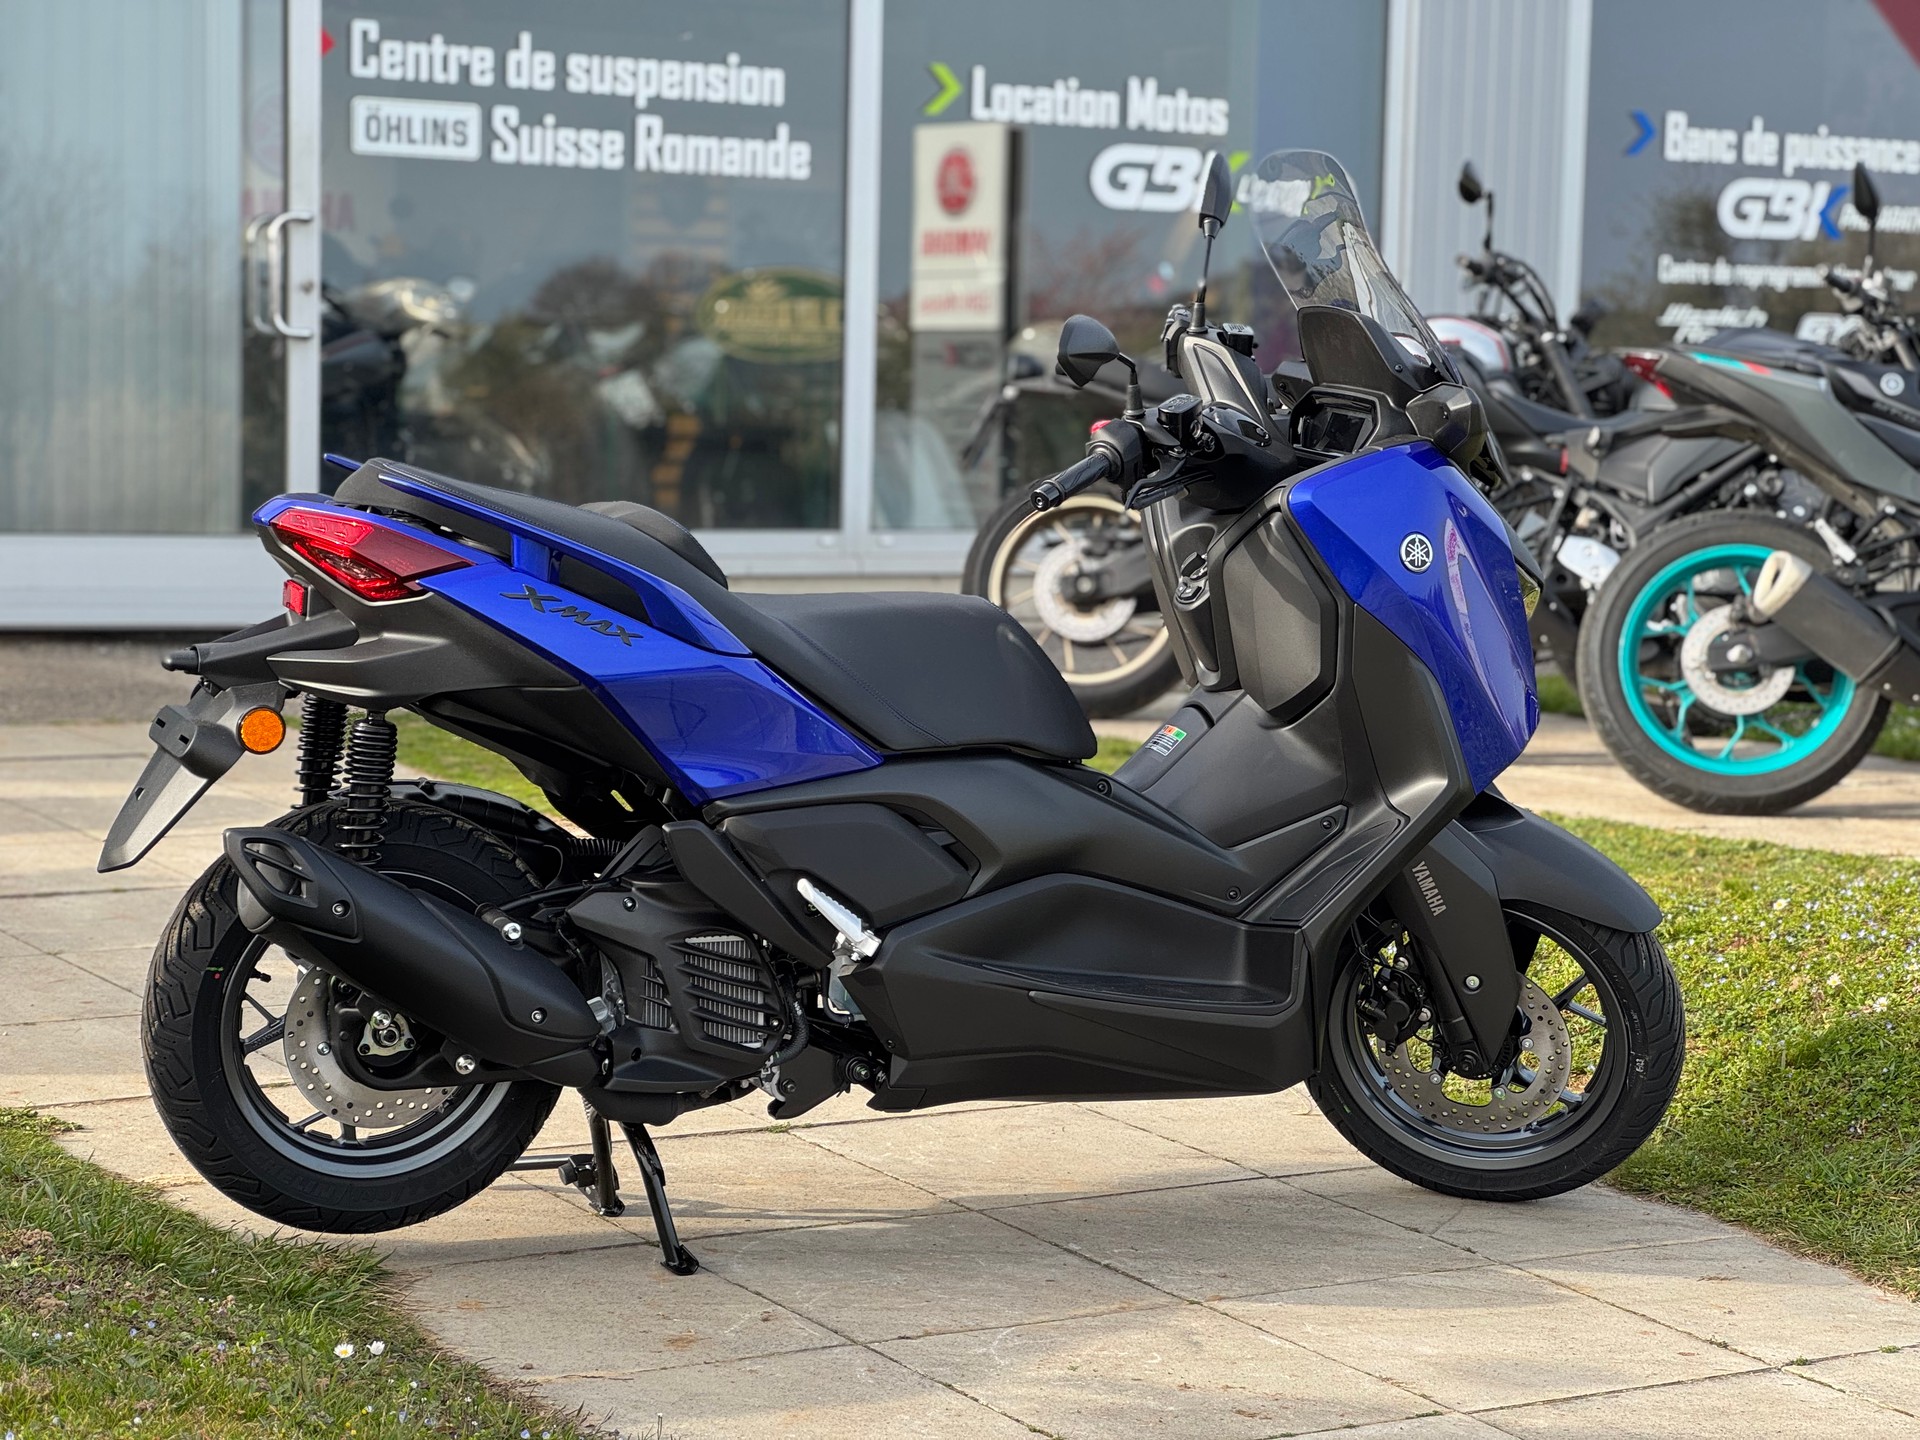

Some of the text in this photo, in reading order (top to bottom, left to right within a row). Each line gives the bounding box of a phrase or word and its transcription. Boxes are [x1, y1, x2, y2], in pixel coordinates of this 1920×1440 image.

[350, 17, 786, 110] Centre de suspension
[971, 64, 1229, 136] Location Motos
[365, 104, 811, 181] ÖHLINS Suisse Romande
[1663, 110, 1920, 177] Banc de puissance
[1717, 177, 1848, 241] GBK
[500, 584, 643, 646] XMAX
[1411, 860, 1447, 917] YAMAHA
